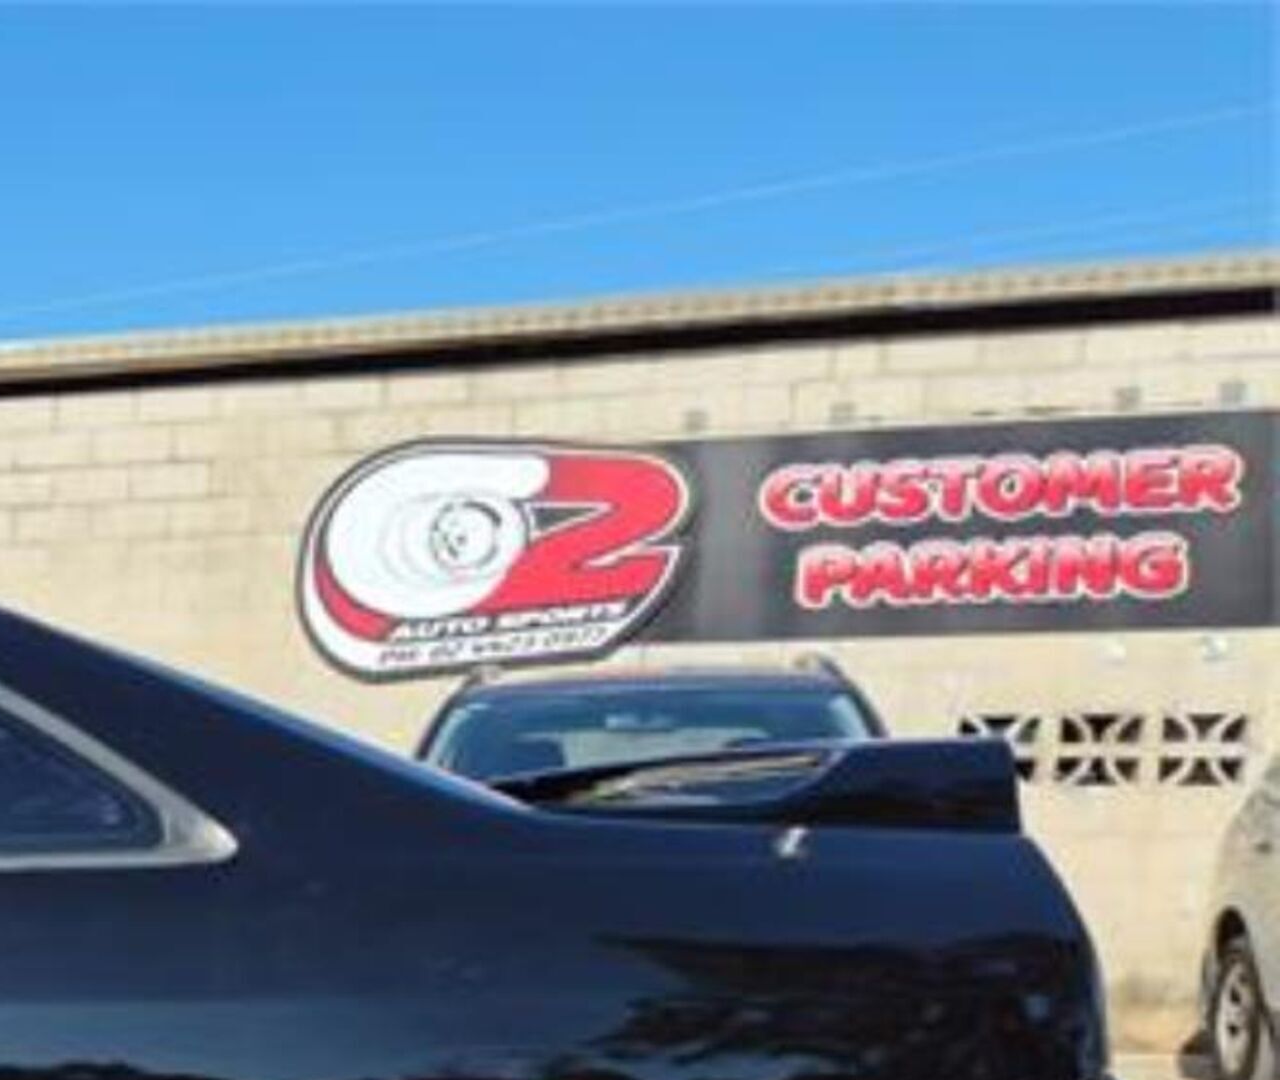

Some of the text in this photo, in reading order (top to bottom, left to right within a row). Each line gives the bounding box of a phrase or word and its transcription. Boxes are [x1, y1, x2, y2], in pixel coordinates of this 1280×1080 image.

[759, 445, 1243, 529] CUSTOMER
[796, 531, 1188, 609] PARKING
[388, 615, 490, 642] AUTO
